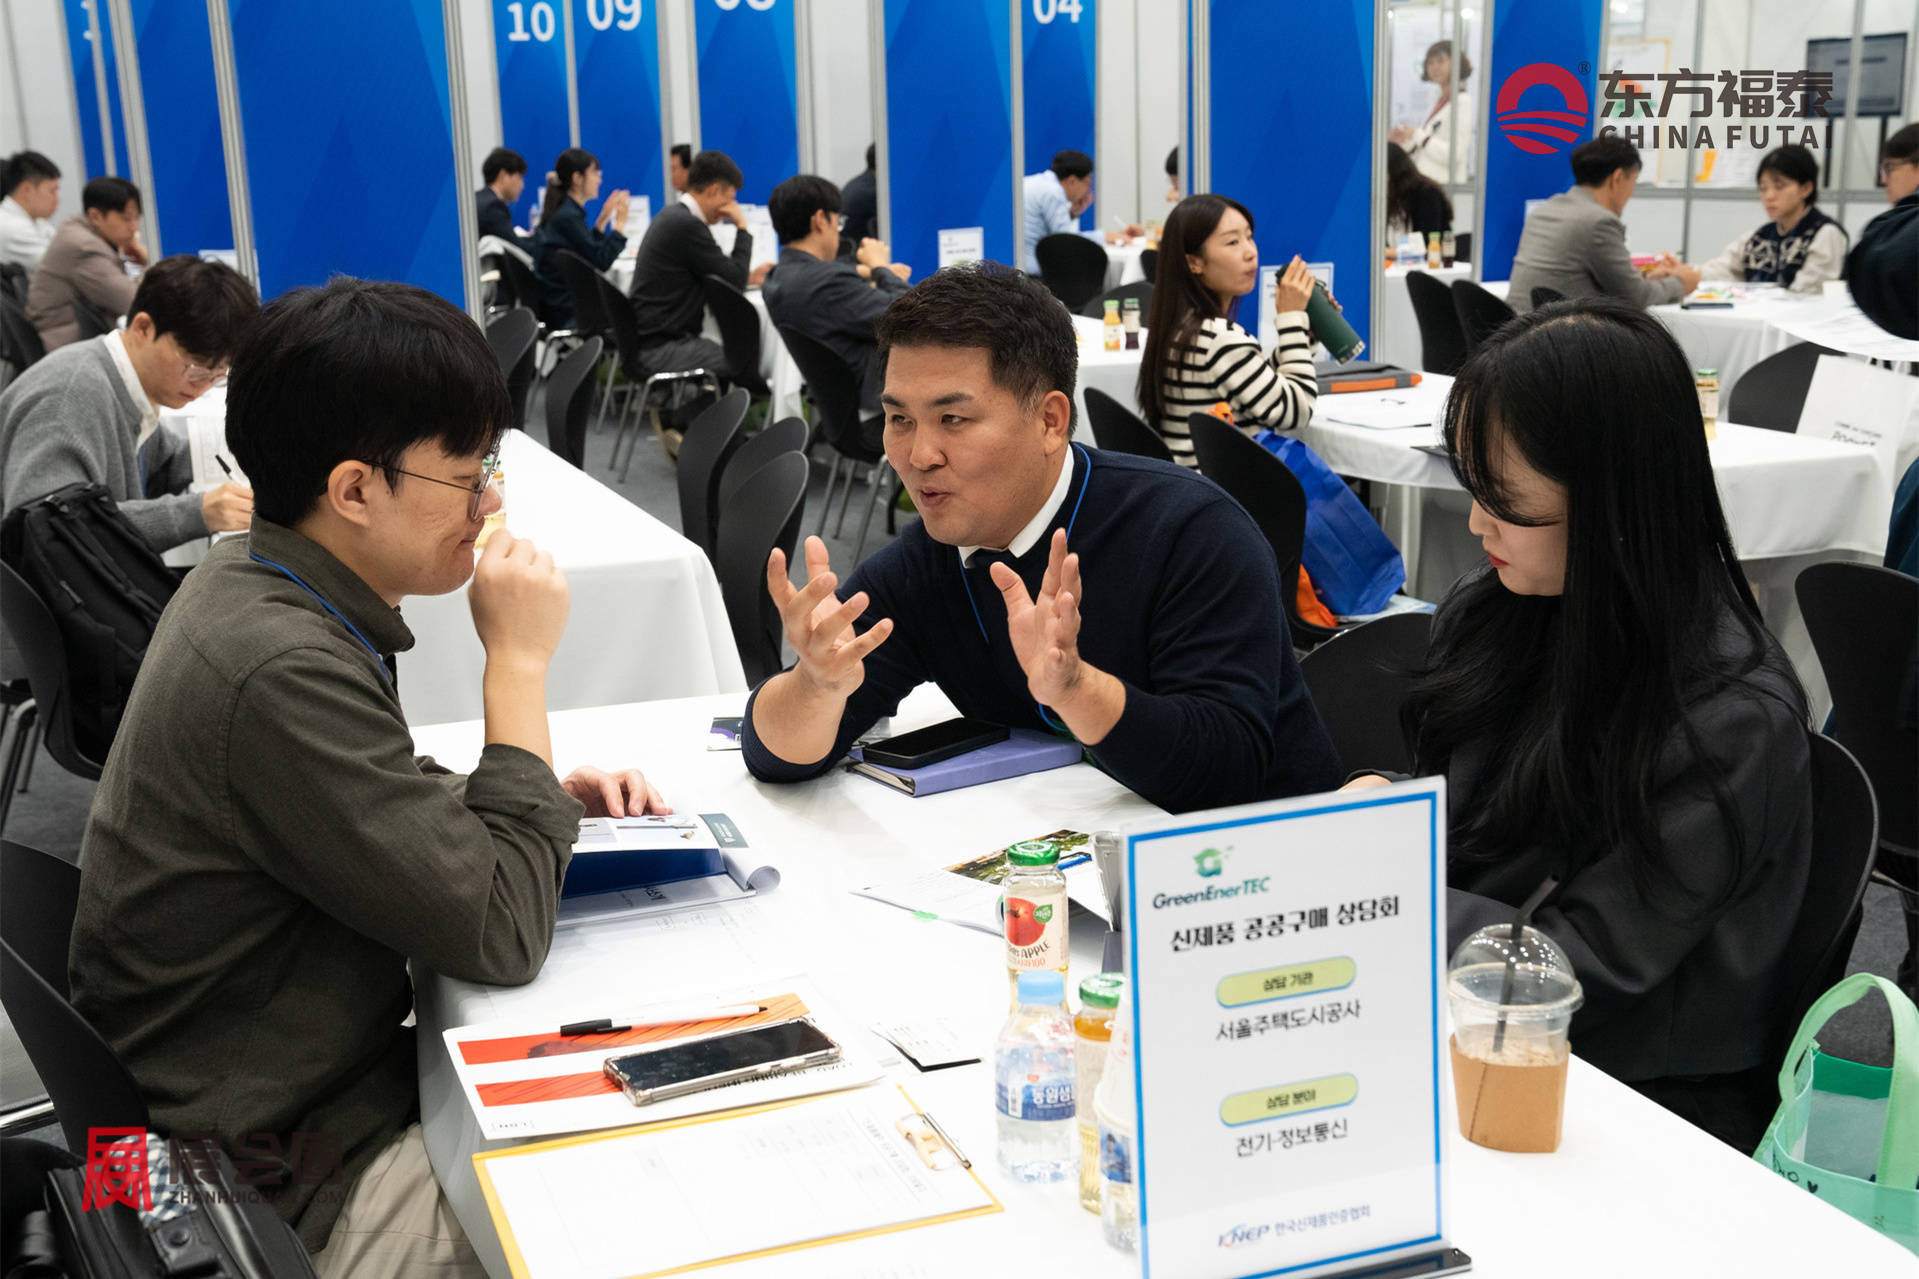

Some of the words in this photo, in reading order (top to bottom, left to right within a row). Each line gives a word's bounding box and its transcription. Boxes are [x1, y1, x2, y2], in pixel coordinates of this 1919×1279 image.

[507, 1, 555, 42] 10
[586, 0, 642, 31] 09
[1153, 877, 1270, 909] GreenEnerTEC
[1170, 922, 1235, 952] 신제품
[1244, 906, 1329, 942] 공공구매
[1336, 896, 1400, 926] 상담회
[1215, 999, 1362, 1042] 서울주택도시공사
